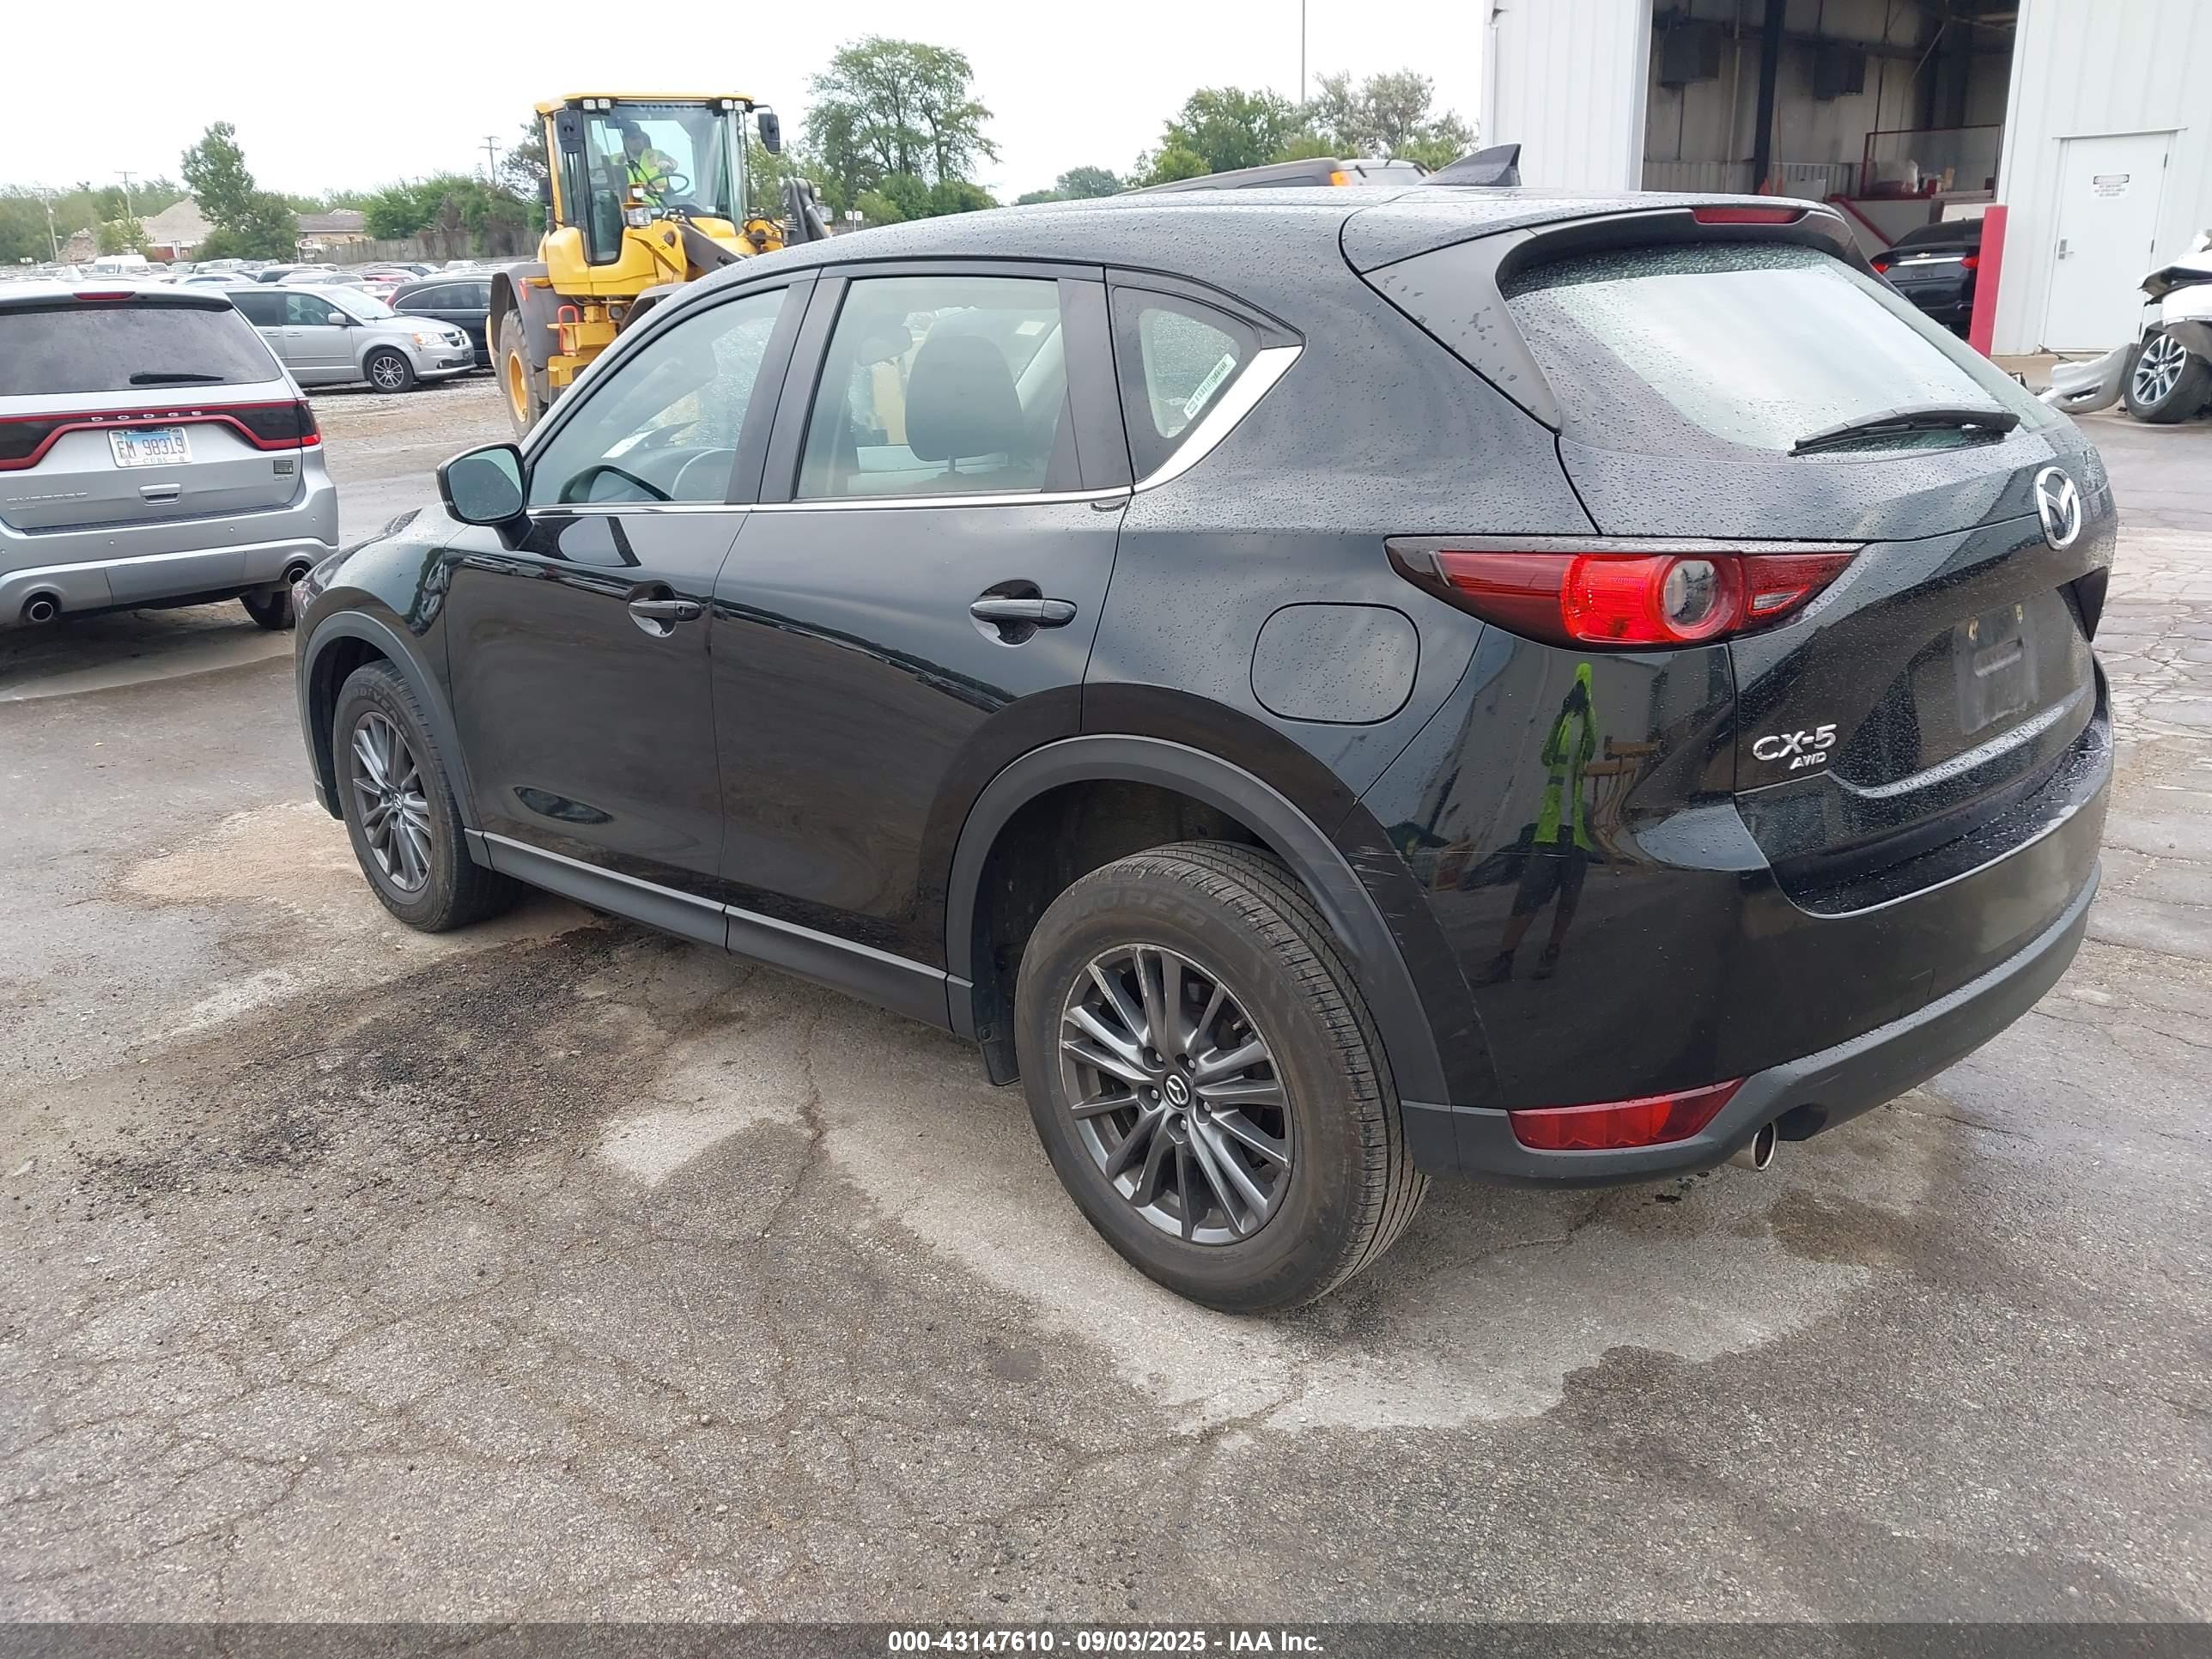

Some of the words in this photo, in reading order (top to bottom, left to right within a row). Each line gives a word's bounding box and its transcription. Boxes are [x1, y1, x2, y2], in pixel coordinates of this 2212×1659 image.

[91, 410, 202, 422] DODGE
[142, 436, 186, 456] 98319
[1753, 723, 1838, 761] CX-5
[1789, 751, 1827, 770] AWD
